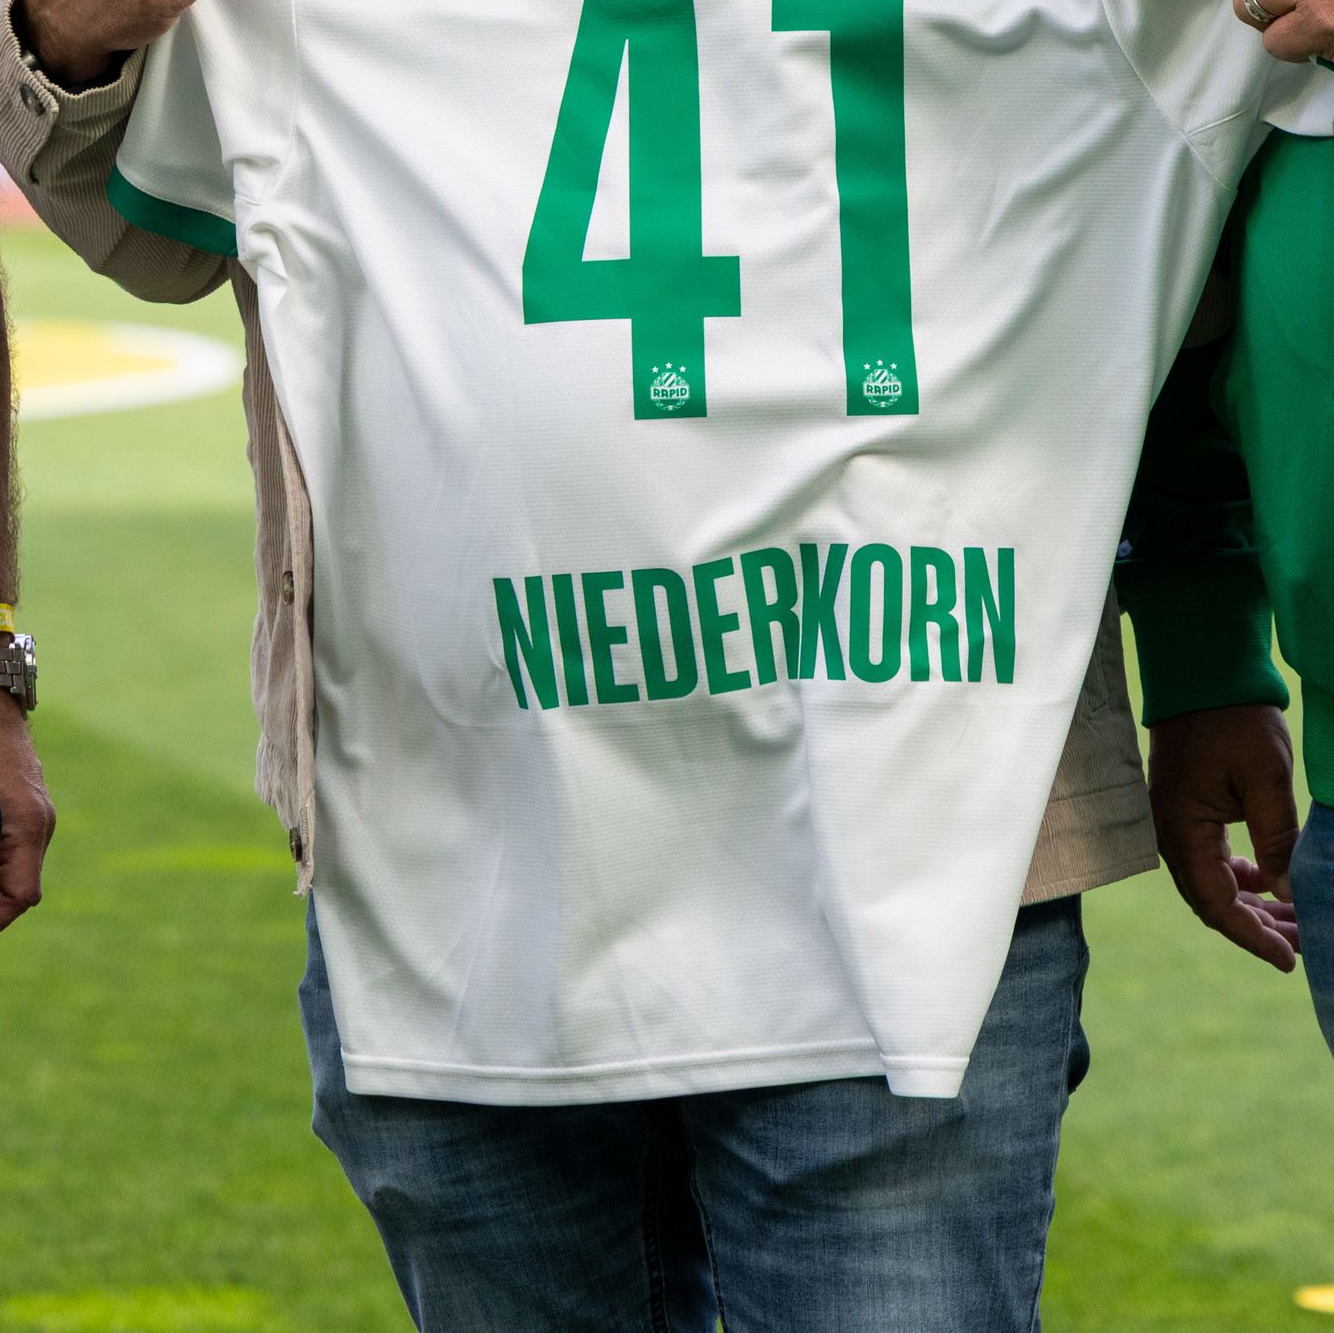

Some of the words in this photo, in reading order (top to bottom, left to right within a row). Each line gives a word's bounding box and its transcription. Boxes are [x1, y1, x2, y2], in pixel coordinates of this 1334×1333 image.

[653, 388, 688, 398] RAPID
[867, 384, 900, 394] RAPID
[492, 543, 1014, 710] NIEDERKORN
